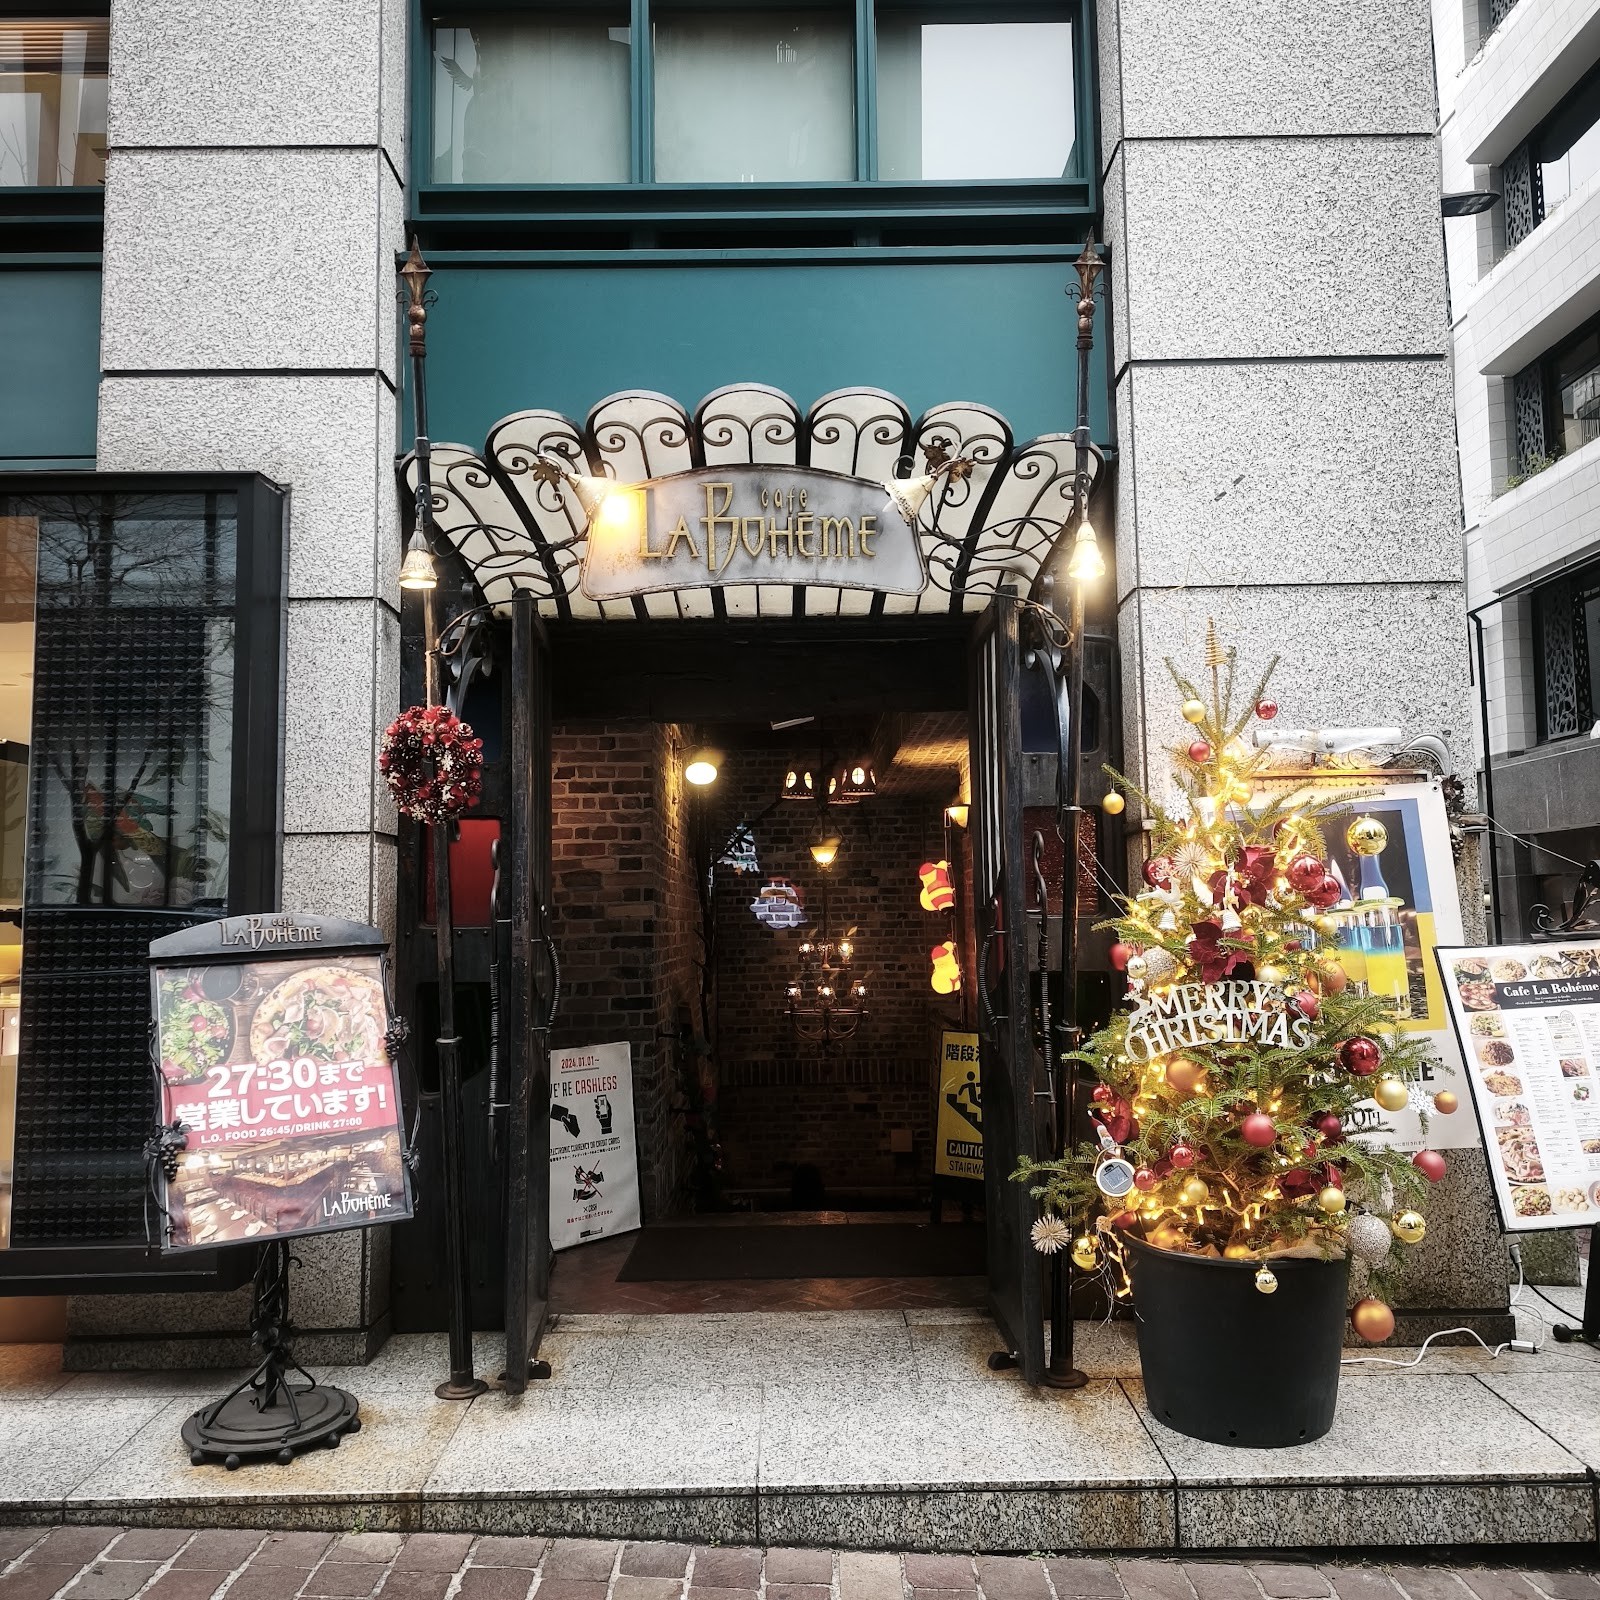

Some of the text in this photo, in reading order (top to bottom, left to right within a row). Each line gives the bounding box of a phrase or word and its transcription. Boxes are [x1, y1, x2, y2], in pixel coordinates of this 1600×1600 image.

[761, 484, 808, 513] cafe
[1149, 980, 1276, 1023] MERRY
[1503, 986, 1531, 997] Cafe
[1532, 984, 1549, 995] La
[1124, 1010, 1312, 1063] CHRISTMAS
[206, 1058, 365, 1098] 27:30まで
[575, 1075, 618, 1095] CASHLESS
[201, 1133, 223, 1144] L.O.
[225, 1130, 258, 1141] FOOD
[332, 1117, 363, 1129] 27:00
